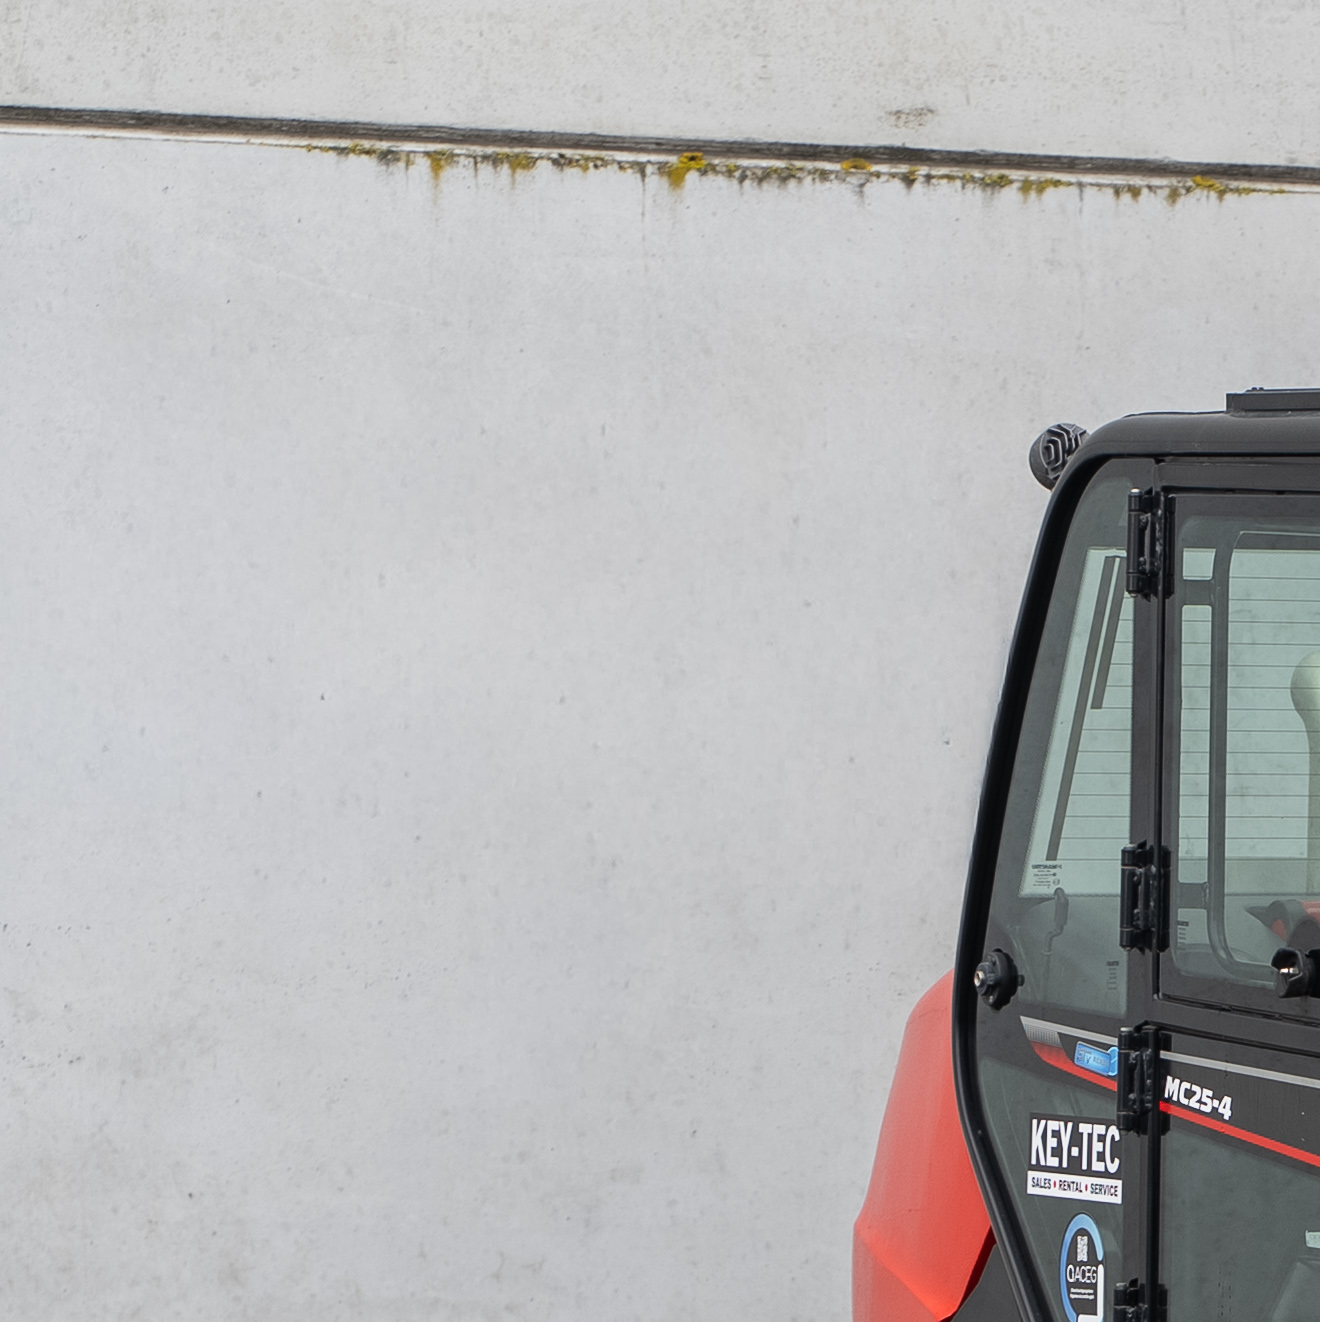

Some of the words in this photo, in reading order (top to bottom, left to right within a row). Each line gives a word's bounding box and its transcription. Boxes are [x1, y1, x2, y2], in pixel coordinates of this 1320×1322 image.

[1164, 1075, 1232, 1121] MC25-4
[1031, 1118, 1120, 1173] KEY-TEC
[1031, 1176, 1052, 1190] SALES
[1058, 1179, 1083, 1193] RENTAL
[1090, 1183, 1119, 1197] SERVICE
